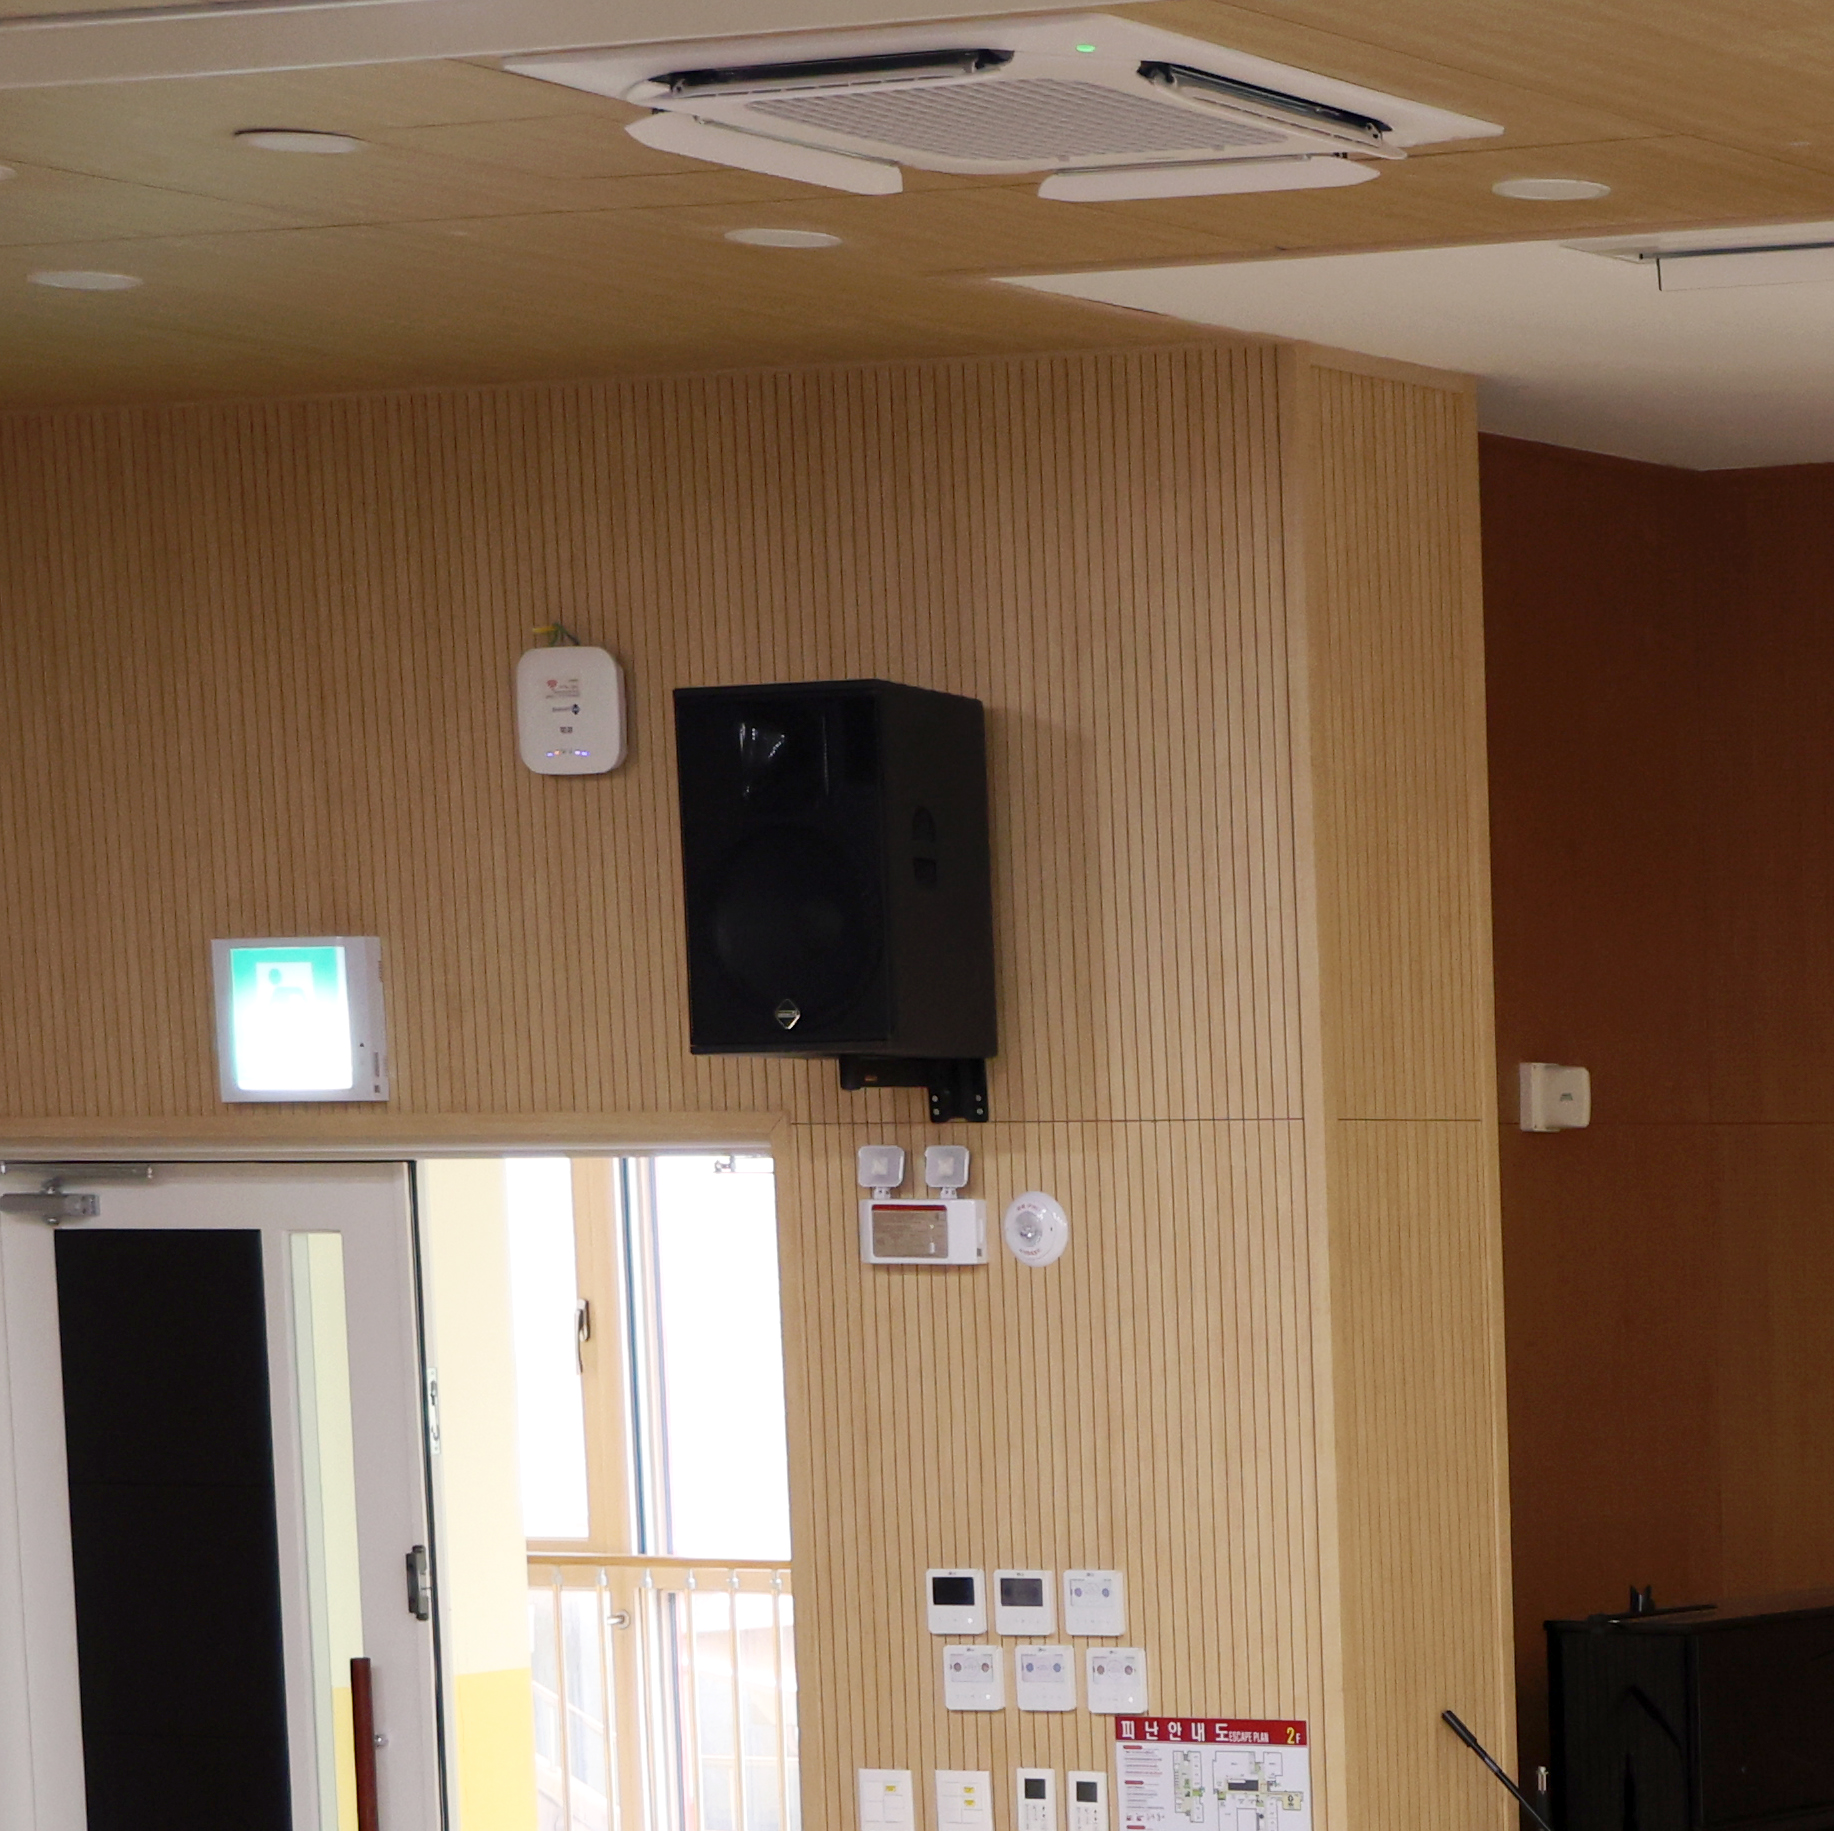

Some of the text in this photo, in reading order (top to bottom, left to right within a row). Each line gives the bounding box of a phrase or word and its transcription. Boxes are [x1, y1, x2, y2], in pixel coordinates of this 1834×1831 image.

[1121, 1720, 1229, 1742] 피난안내도
[1229, 1731, 1269, 1743] ESCAPE PLAN
